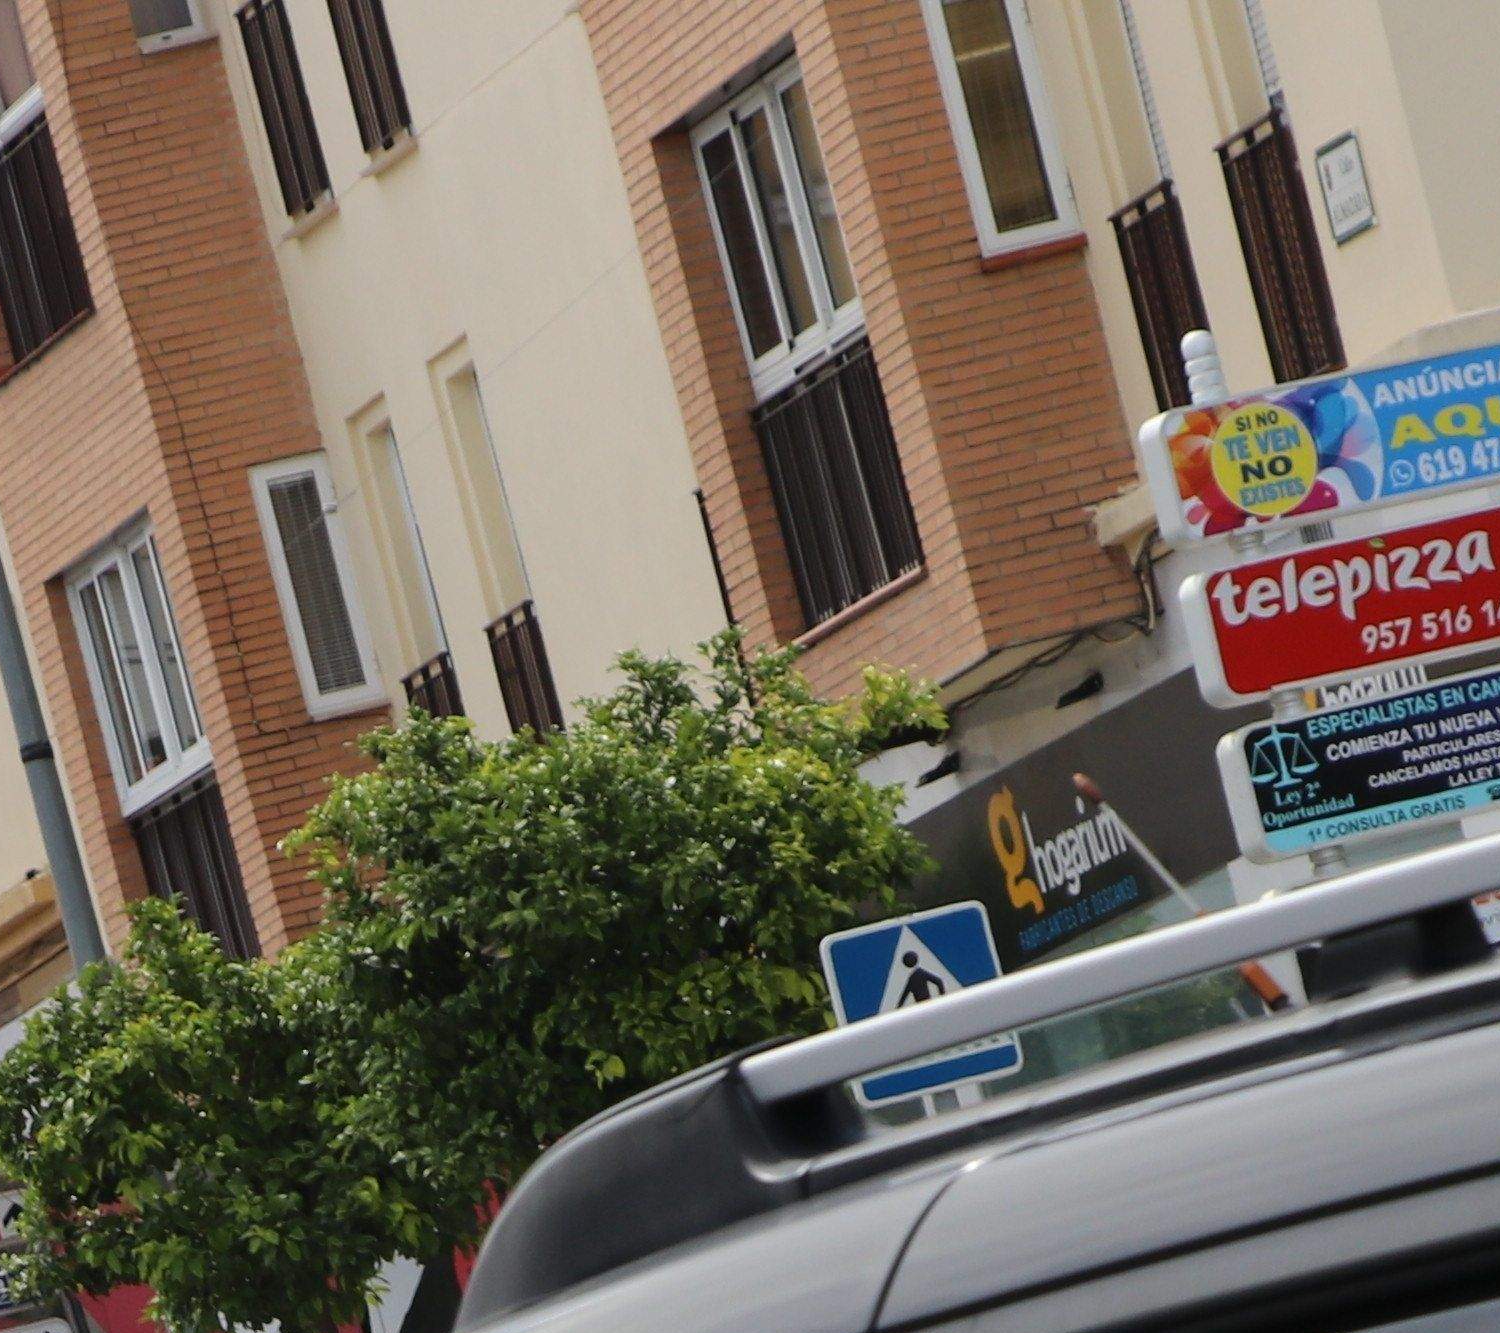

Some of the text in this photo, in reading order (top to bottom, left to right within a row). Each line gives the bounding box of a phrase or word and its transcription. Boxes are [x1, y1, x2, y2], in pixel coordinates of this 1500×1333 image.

[1235, 409, 1279, 433] SI NO
[1222, 425, 1302, 462] TE VEN
[1241, 454, 1293, 483] NO
[1417, 447, 1466, 484] 619
[1239, 477, 1306, 507] EXISTES
[1211, 529, 1495, 626] telepizza
[1361, 619, 1412, 654] 957
[1422, 604, 1474, 640] 516
[1306, 692, 1438, 739] ESPECIALISTAS
[1440, 685, 1466, 707] EN
[1326, 727, 1413, 761] COMIENZA
[1412, 722, 1437, 741] TU
[1439, 707, 1497, 737] NUEVA
[1368, 754, 1462, 789] CANCELAMOS
[1448, 772, 1469, 787] LA
[1468, 765, 1495, 783] LEY
[1263, 793, 1355, 828] Oportunidad
[1325, 809, 1408, 840] CONSULTA
[1409, 794, 1467, 819] GRATIS
[1021, 796, 1128, 895] hogarium
